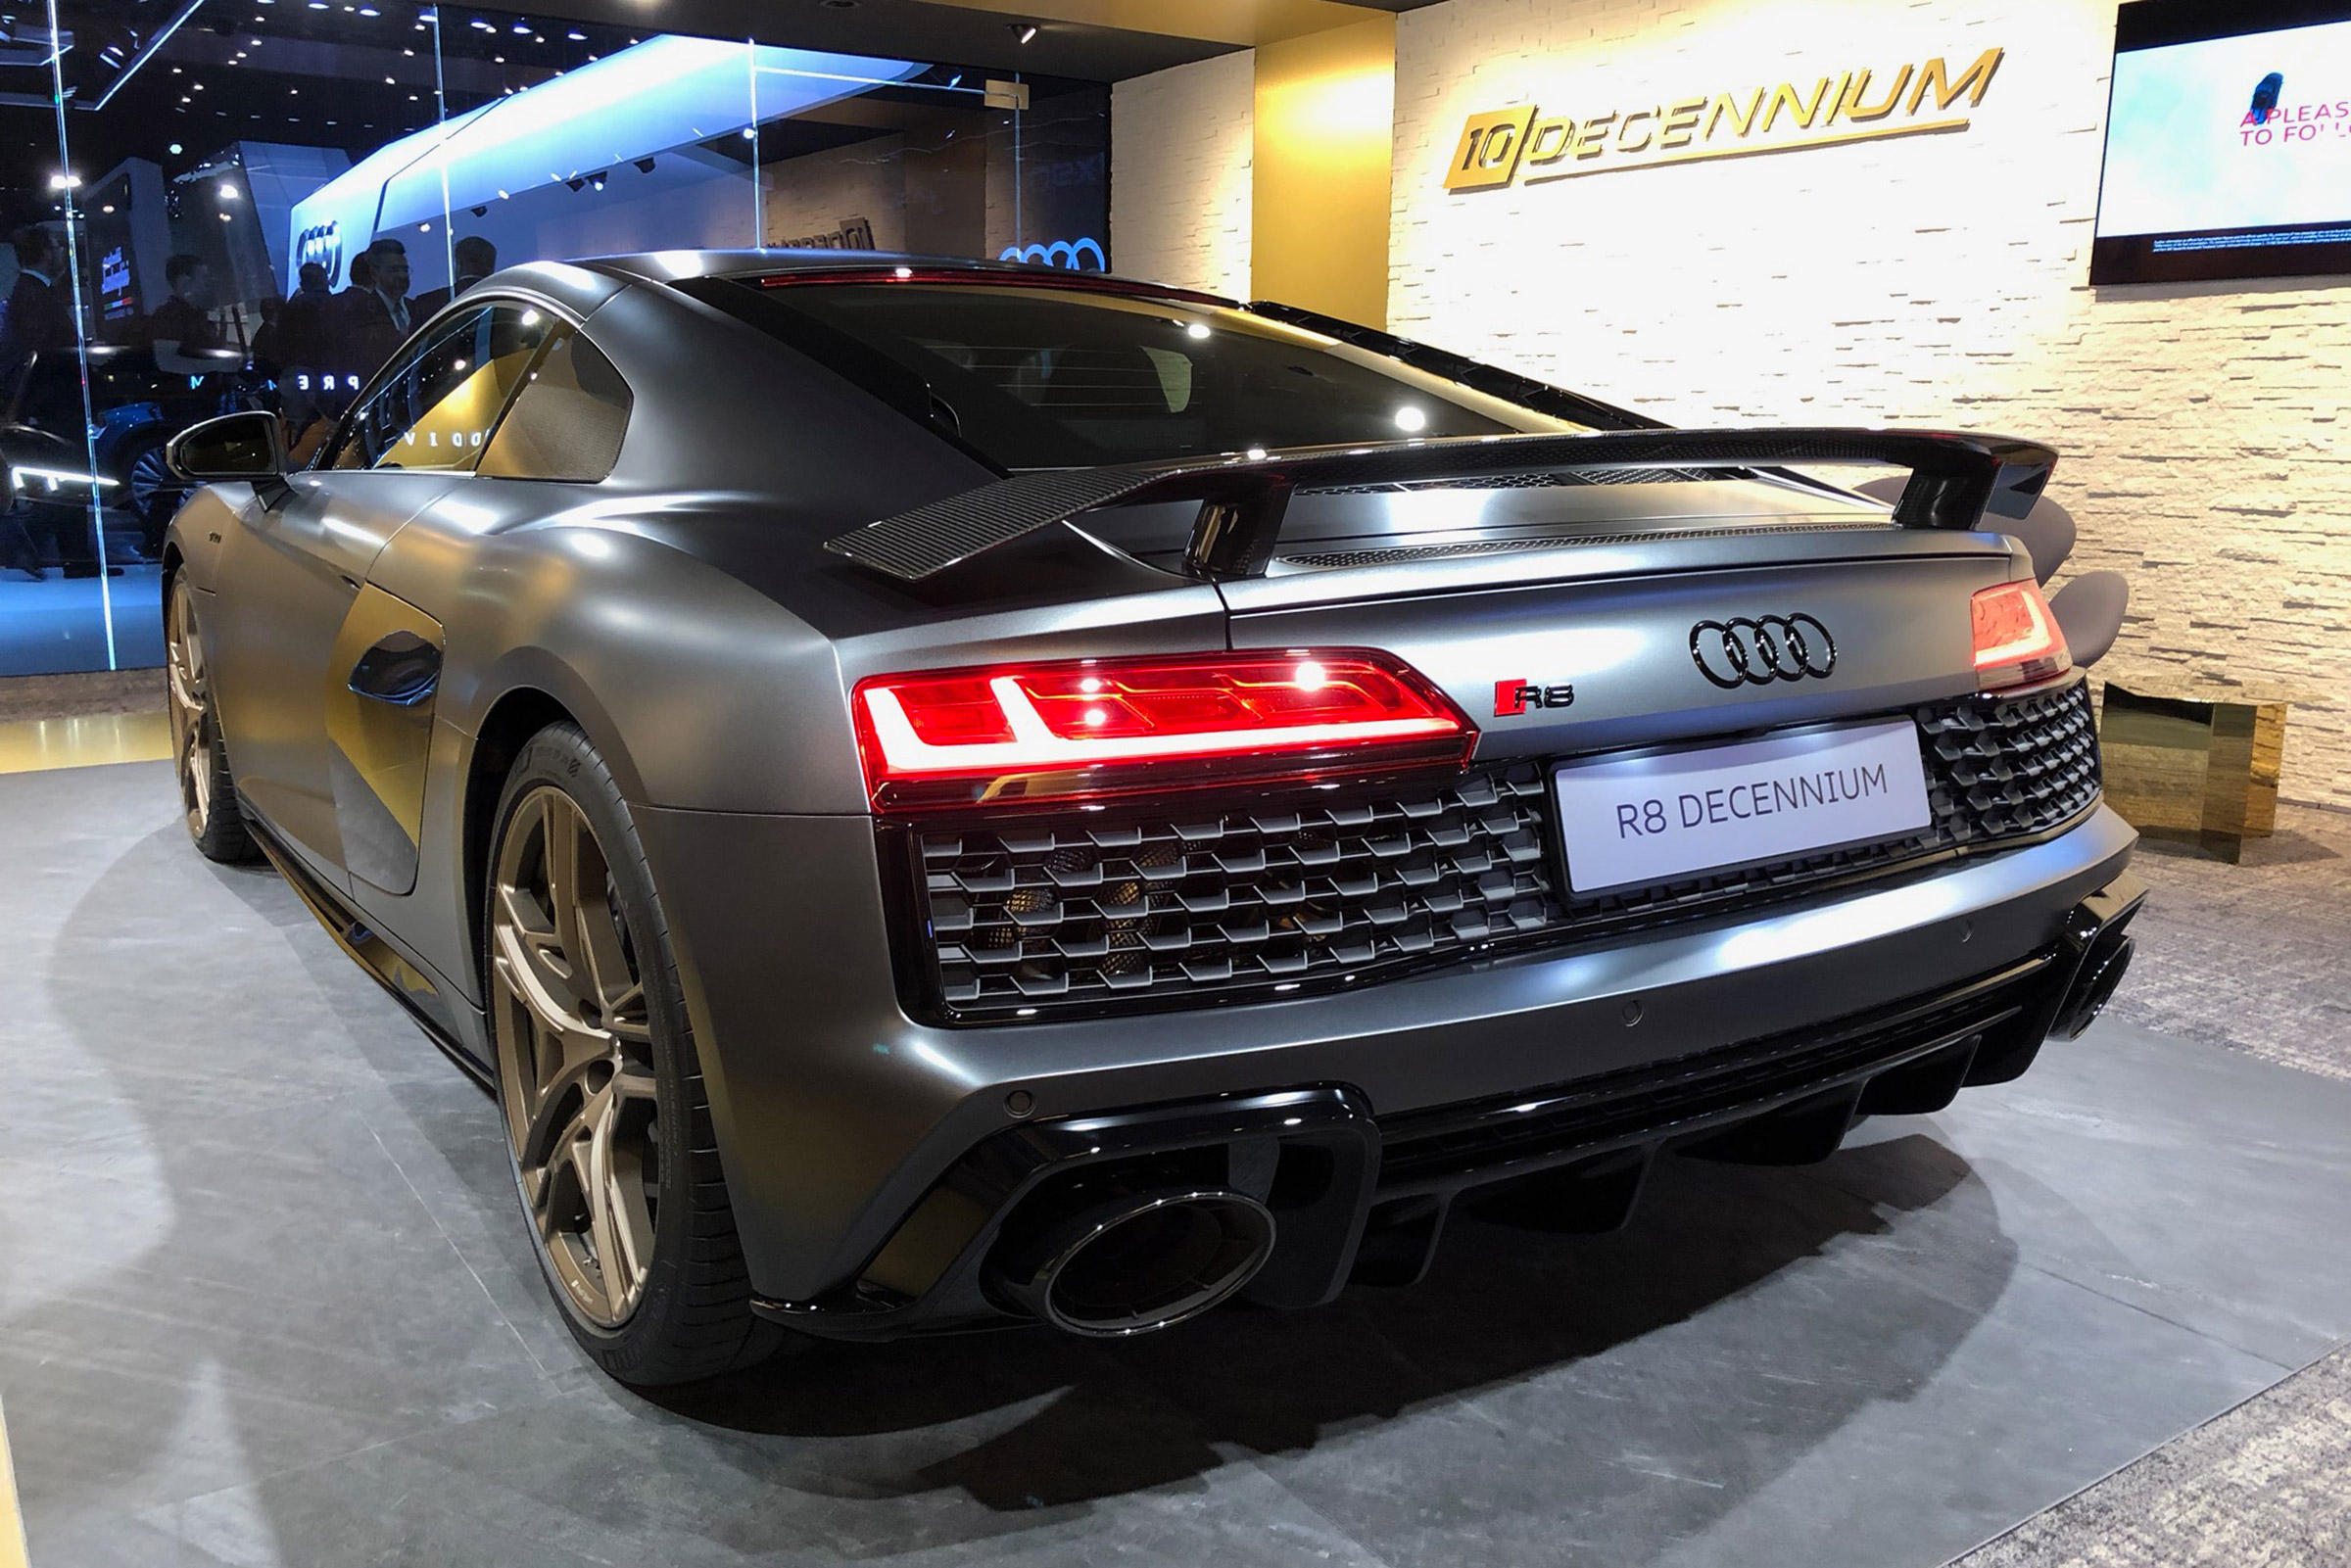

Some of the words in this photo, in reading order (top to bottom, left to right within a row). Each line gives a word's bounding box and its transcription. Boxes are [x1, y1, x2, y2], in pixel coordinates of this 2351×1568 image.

[1462, 122, 1515, 170] 10
[1521, 47, 2004, 165] DECENNIUM
[2239, 111, 2258, 127] A
[2240, 129, 2273, 146] TO
[1513, 685, 1575, 709] R8
[1616, 799, 1667, 839] R8
[1678, 764, 1888, 829] DECENNIUM
